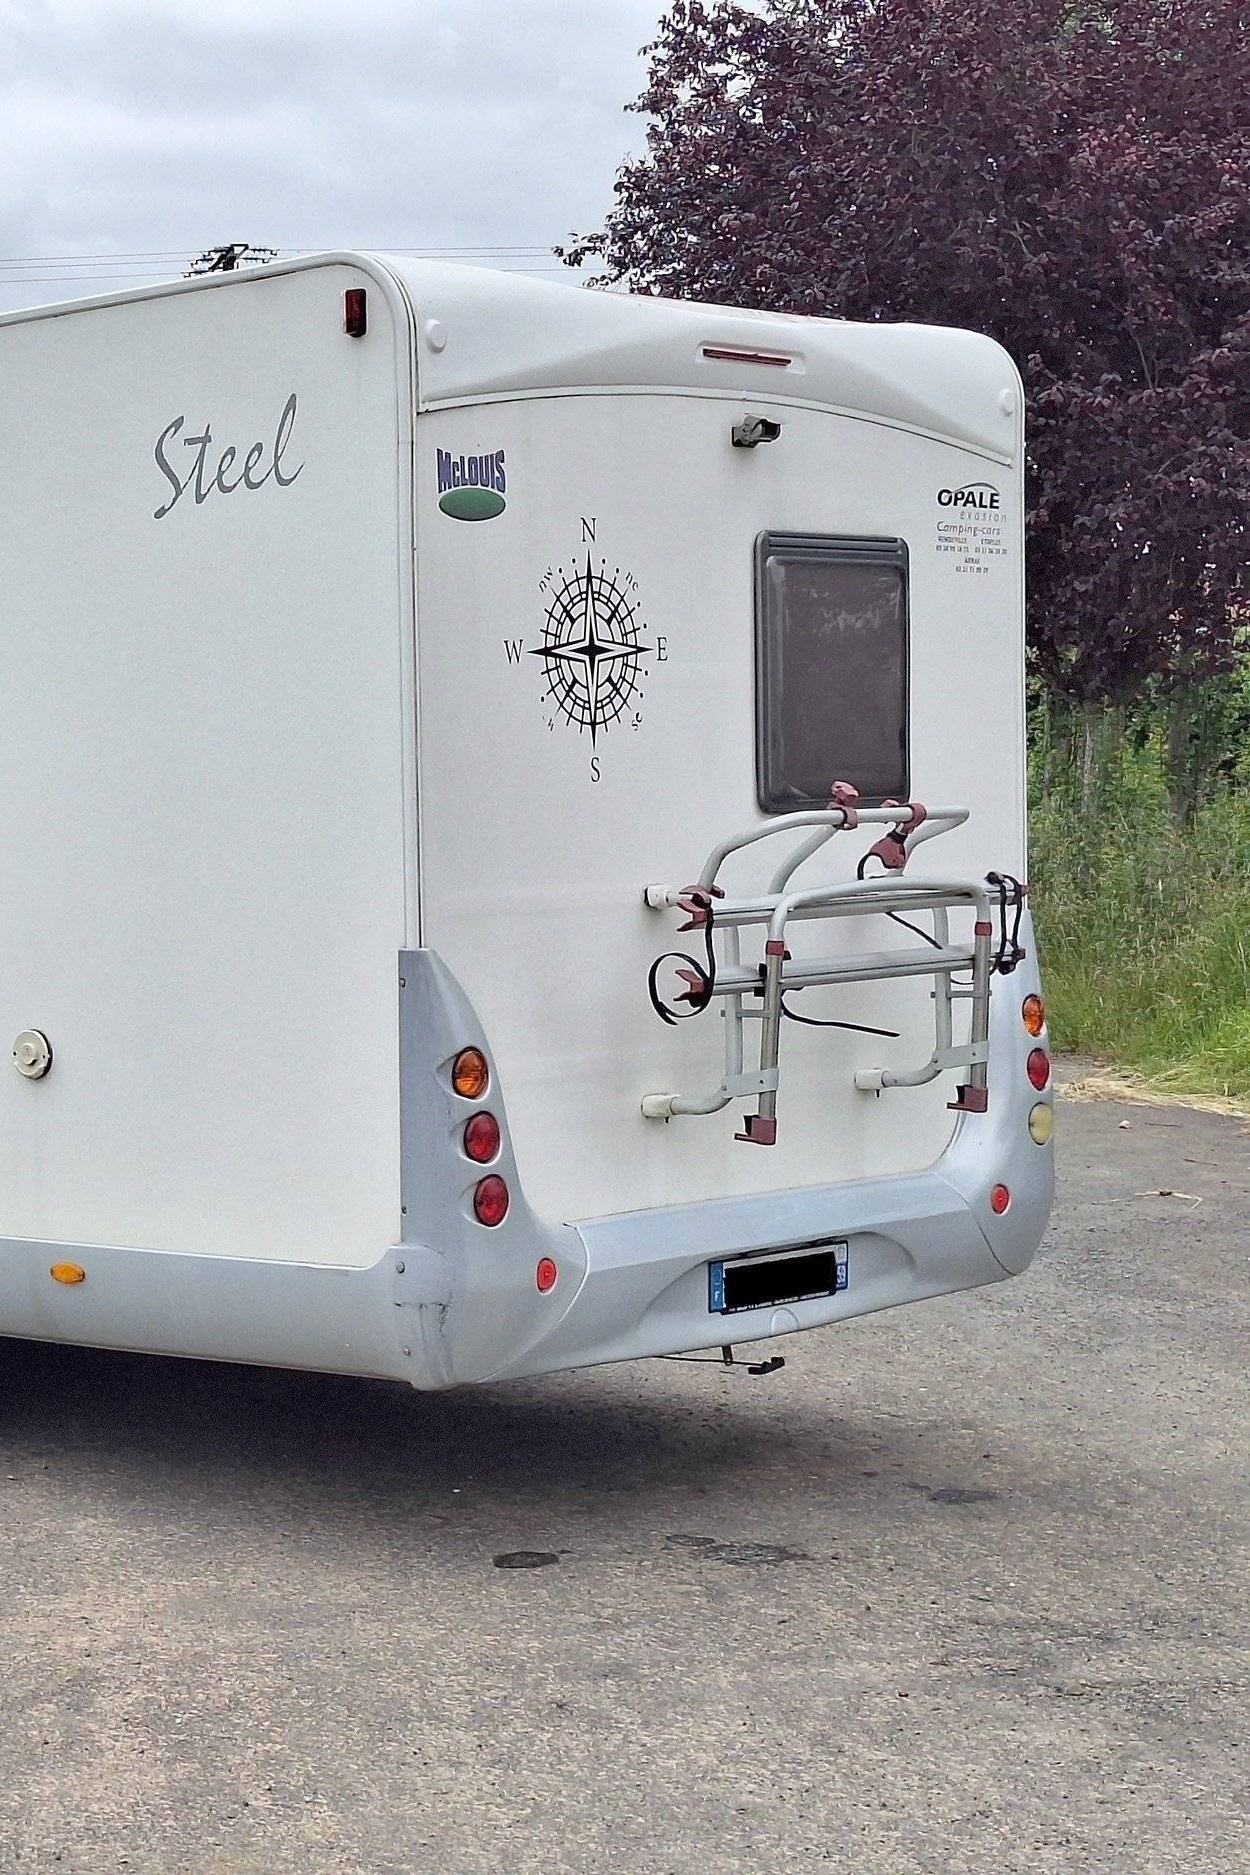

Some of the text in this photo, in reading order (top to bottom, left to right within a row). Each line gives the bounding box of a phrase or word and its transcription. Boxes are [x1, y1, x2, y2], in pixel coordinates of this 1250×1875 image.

[154, 393, 305, 519] Steel
[937, 489, 1000, 510] OPALE
[581, 517, 597, 543] N
[936, 521, 1001, 537] Camping-cars
[504, 639, 524, 664] W
[656, 636, 668, 661] E
[590, 756, 601, 783] S
